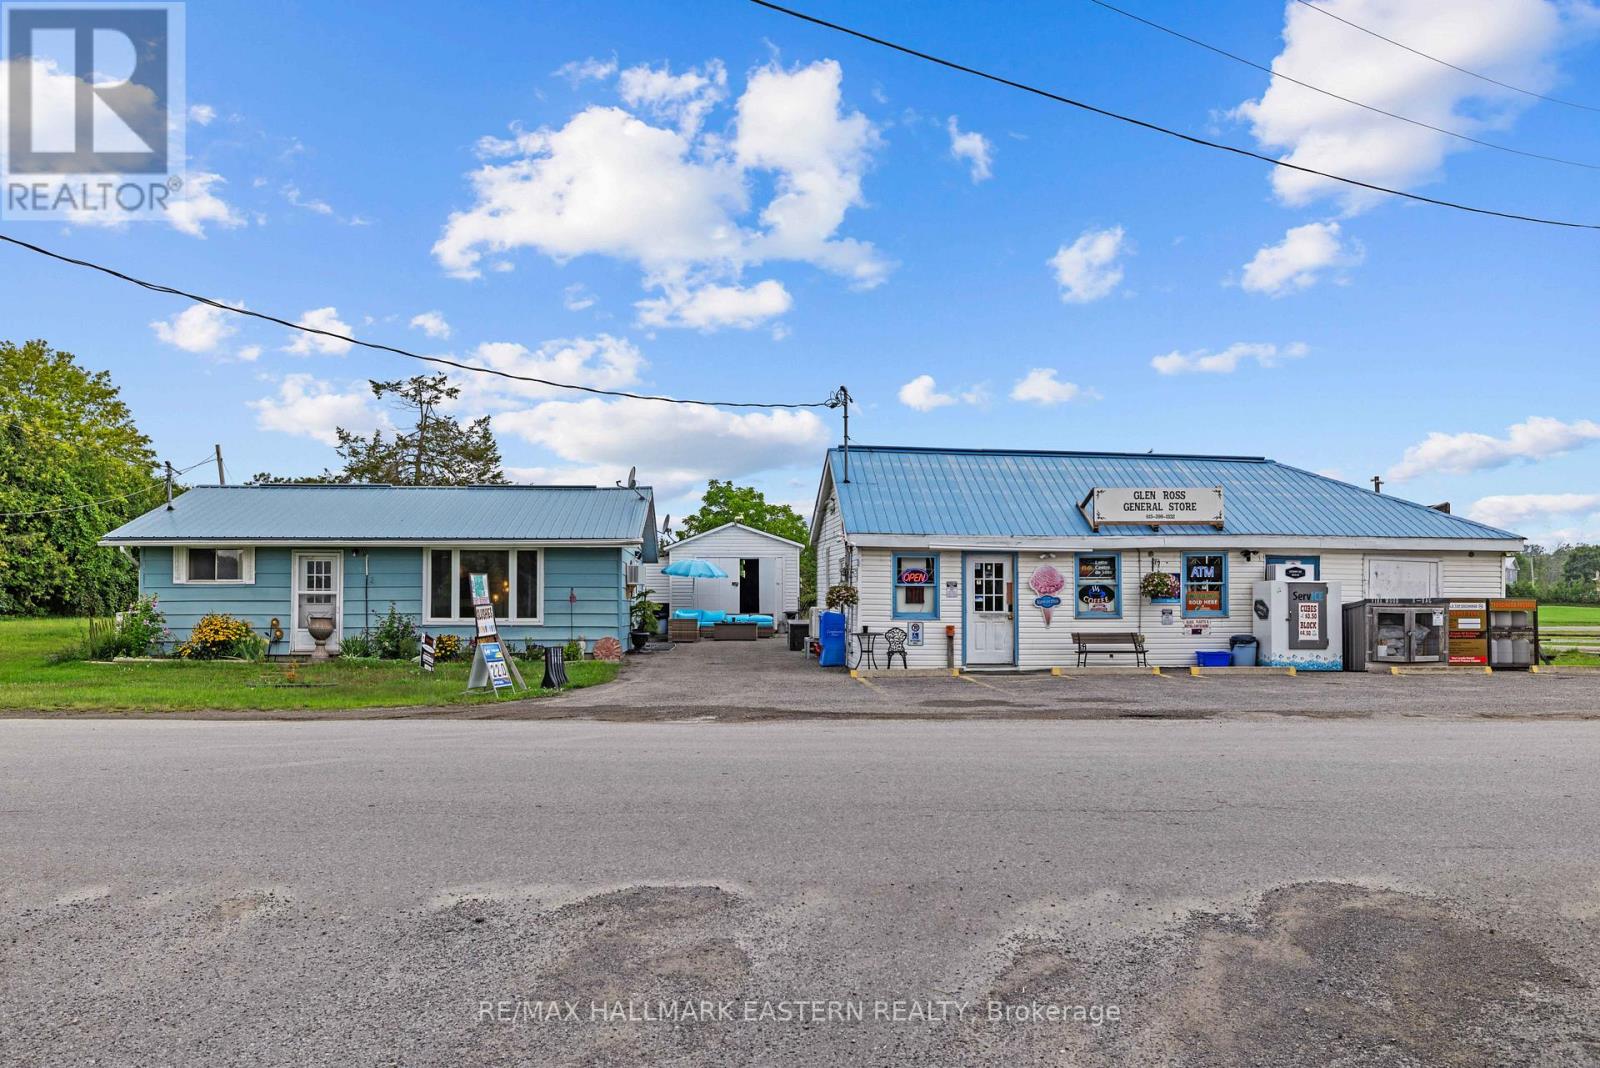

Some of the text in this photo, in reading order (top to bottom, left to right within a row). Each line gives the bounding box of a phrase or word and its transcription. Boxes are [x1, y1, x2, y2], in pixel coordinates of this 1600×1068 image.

[1133, 490, 1186, 500] GLEN ROSS
[1123, 502, 1197, 512] GENERAL STORE
[1190, 566, 1215, 577] ATM
[904, 573, 926, 582] OPEN
[1300, 604, 1317, 612] CUBES
[1300, 621, 1317, 629] BLOCK
